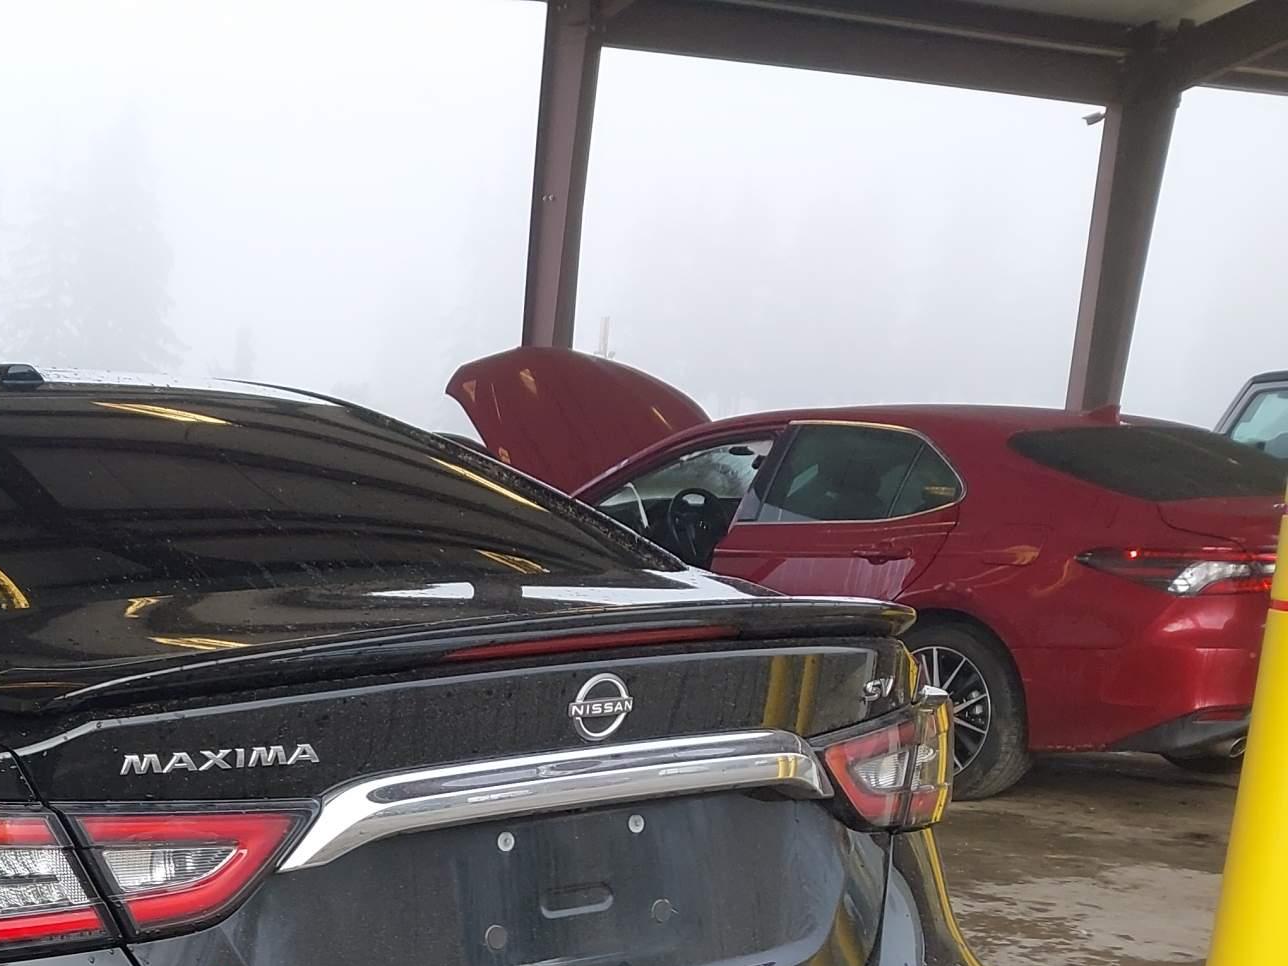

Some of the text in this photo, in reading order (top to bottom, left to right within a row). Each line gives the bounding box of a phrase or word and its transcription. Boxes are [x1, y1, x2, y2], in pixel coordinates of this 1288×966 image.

[865, 678, 894, 702] SV
[571, 700, 633, 716] NISSAN
[119, 743, 320, 775] MAXIMA
